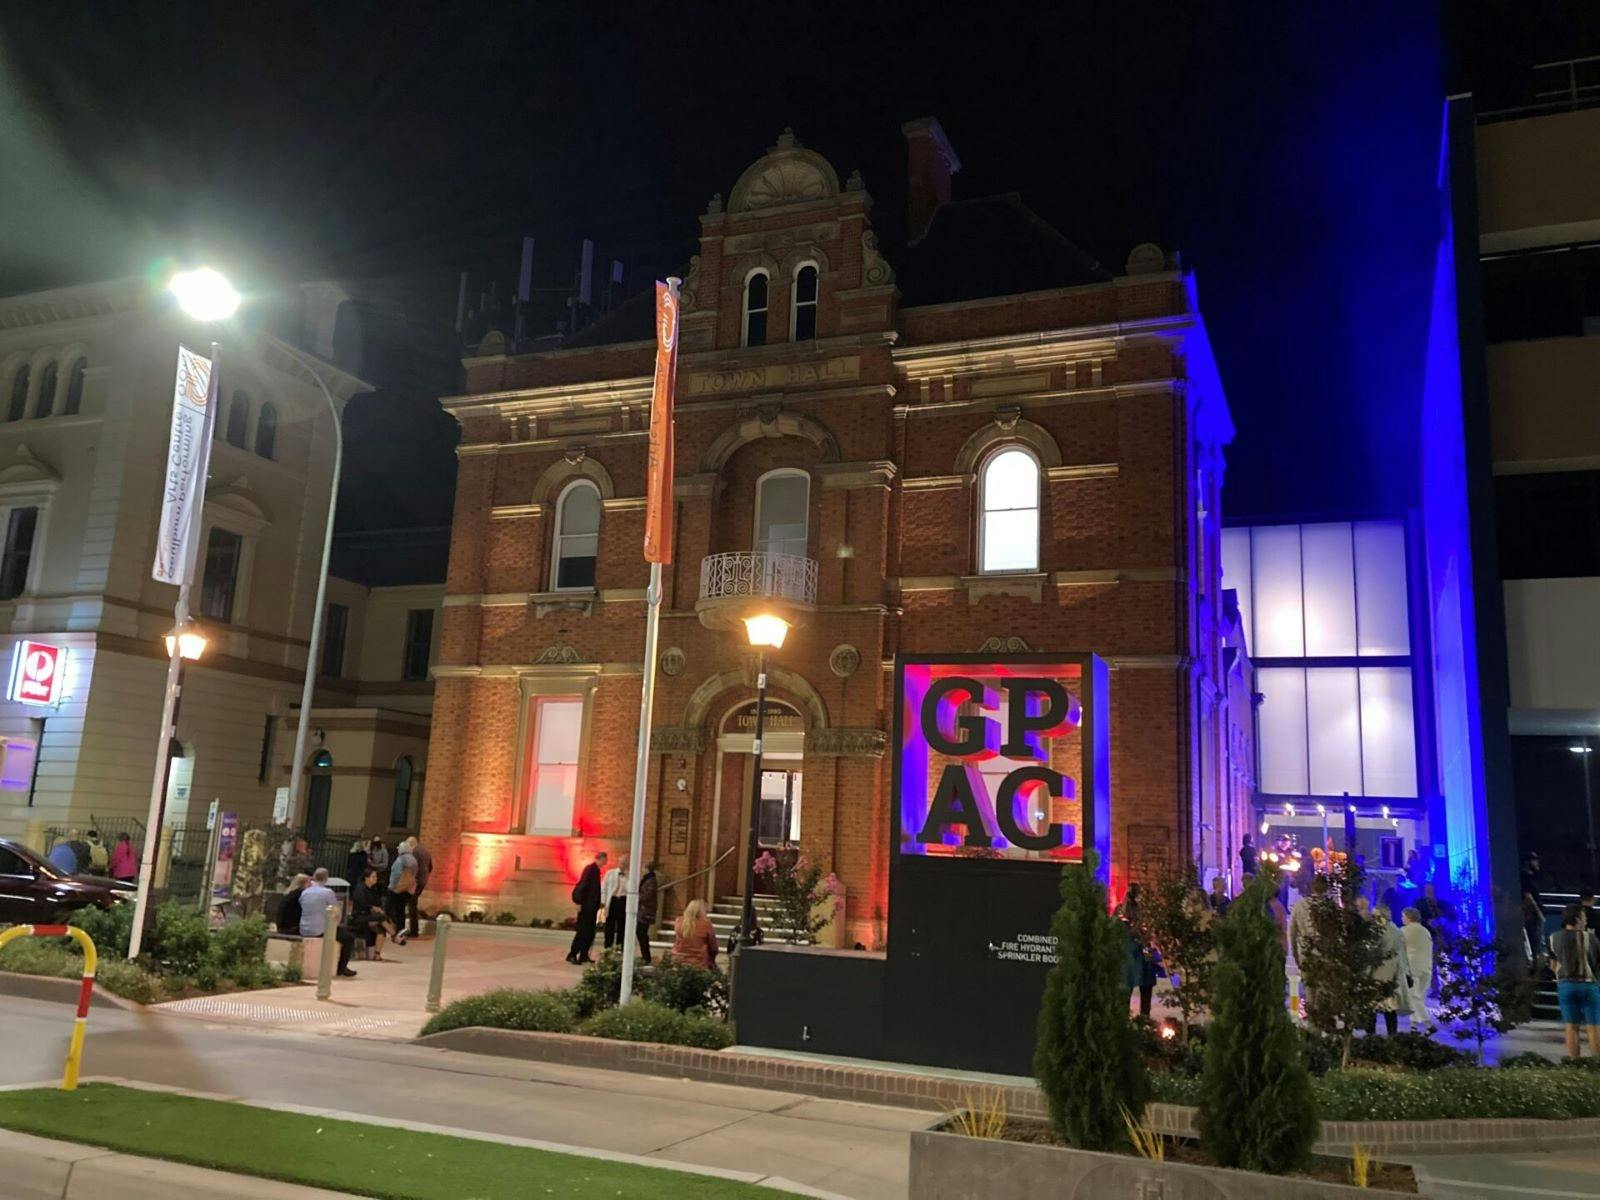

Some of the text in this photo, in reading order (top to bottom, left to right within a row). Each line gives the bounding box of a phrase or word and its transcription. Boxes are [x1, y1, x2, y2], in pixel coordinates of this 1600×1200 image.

[693, 359, 854, 391] TOWN HALL
[1017, 934, 1058, 944] COMBINED
[1001, 942, 1055, 953] FIRE HYDRANT
[998, 952, 1041, 961] SPRINKLER
